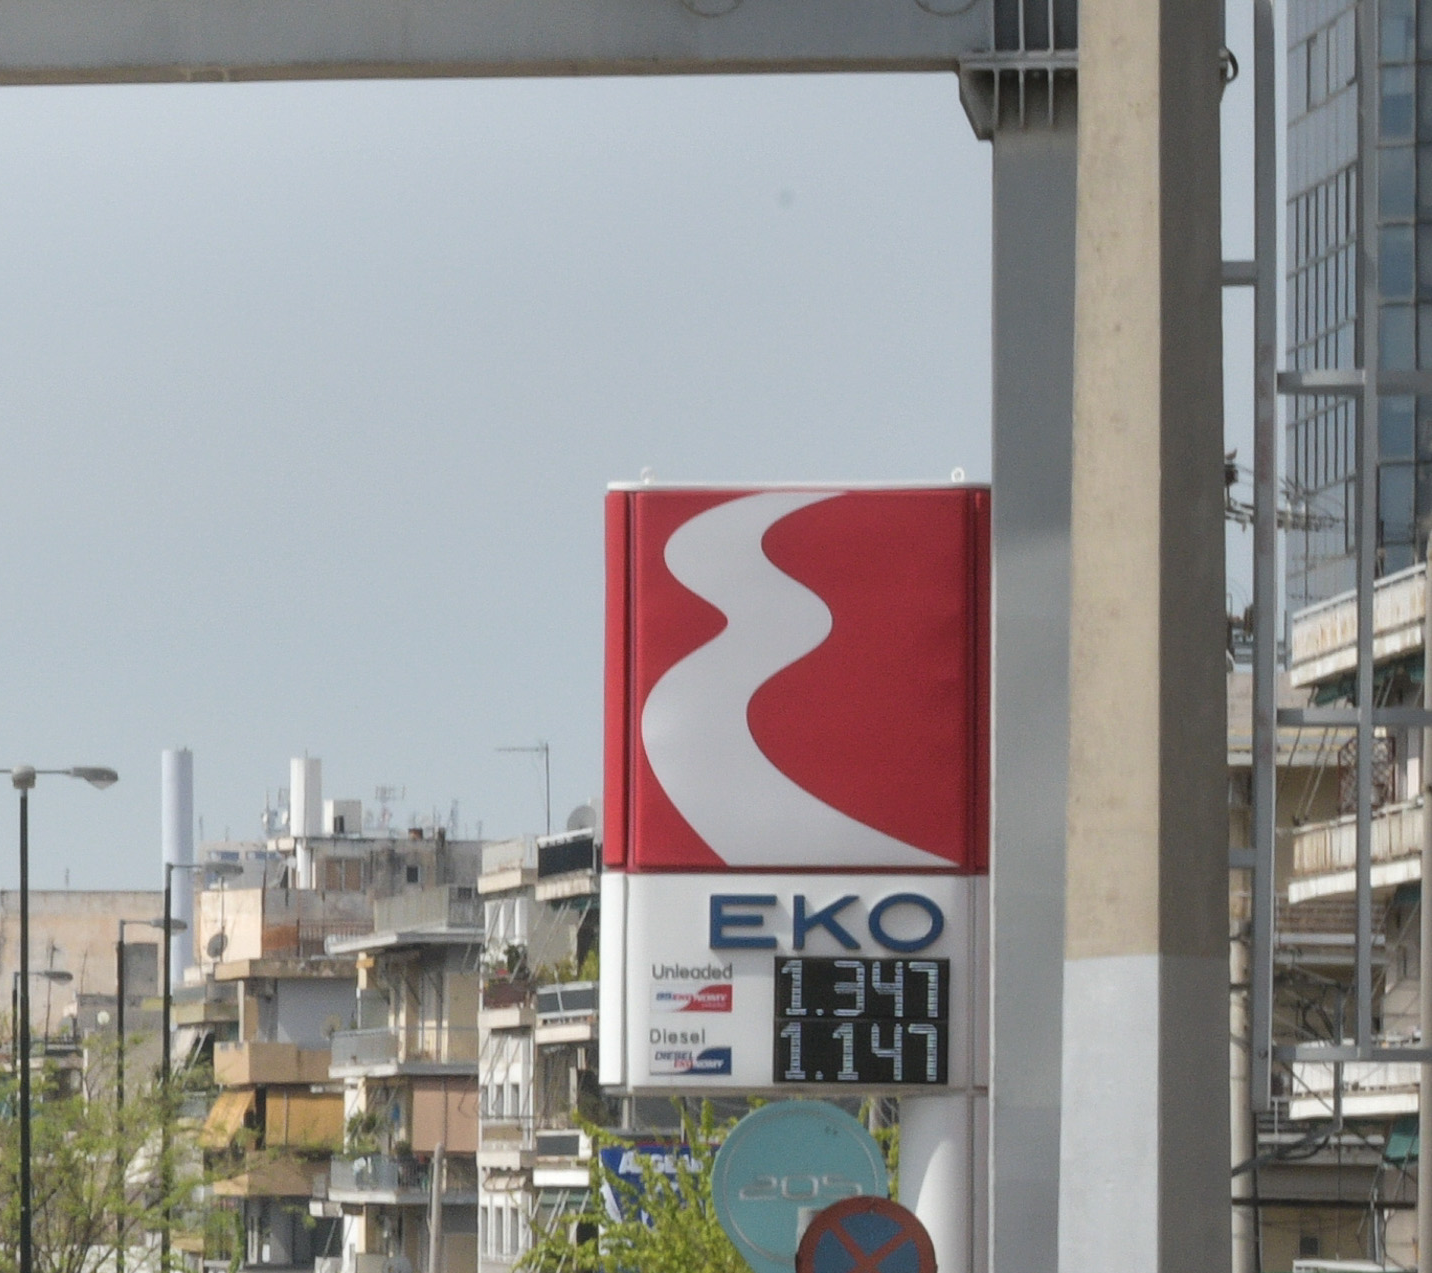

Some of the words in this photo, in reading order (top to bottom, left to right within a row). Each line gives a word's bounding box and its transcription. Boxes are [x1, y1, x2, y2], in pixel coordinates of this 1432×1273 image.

[709, 893, 945, 953] EKO
[652, 963, 733, 980] Unleaded
[781, 959, 939, 1018] 1.347
[649, 1028, 705, 1045] Diesel
[780, 1022, 938, 1082] 1.147
